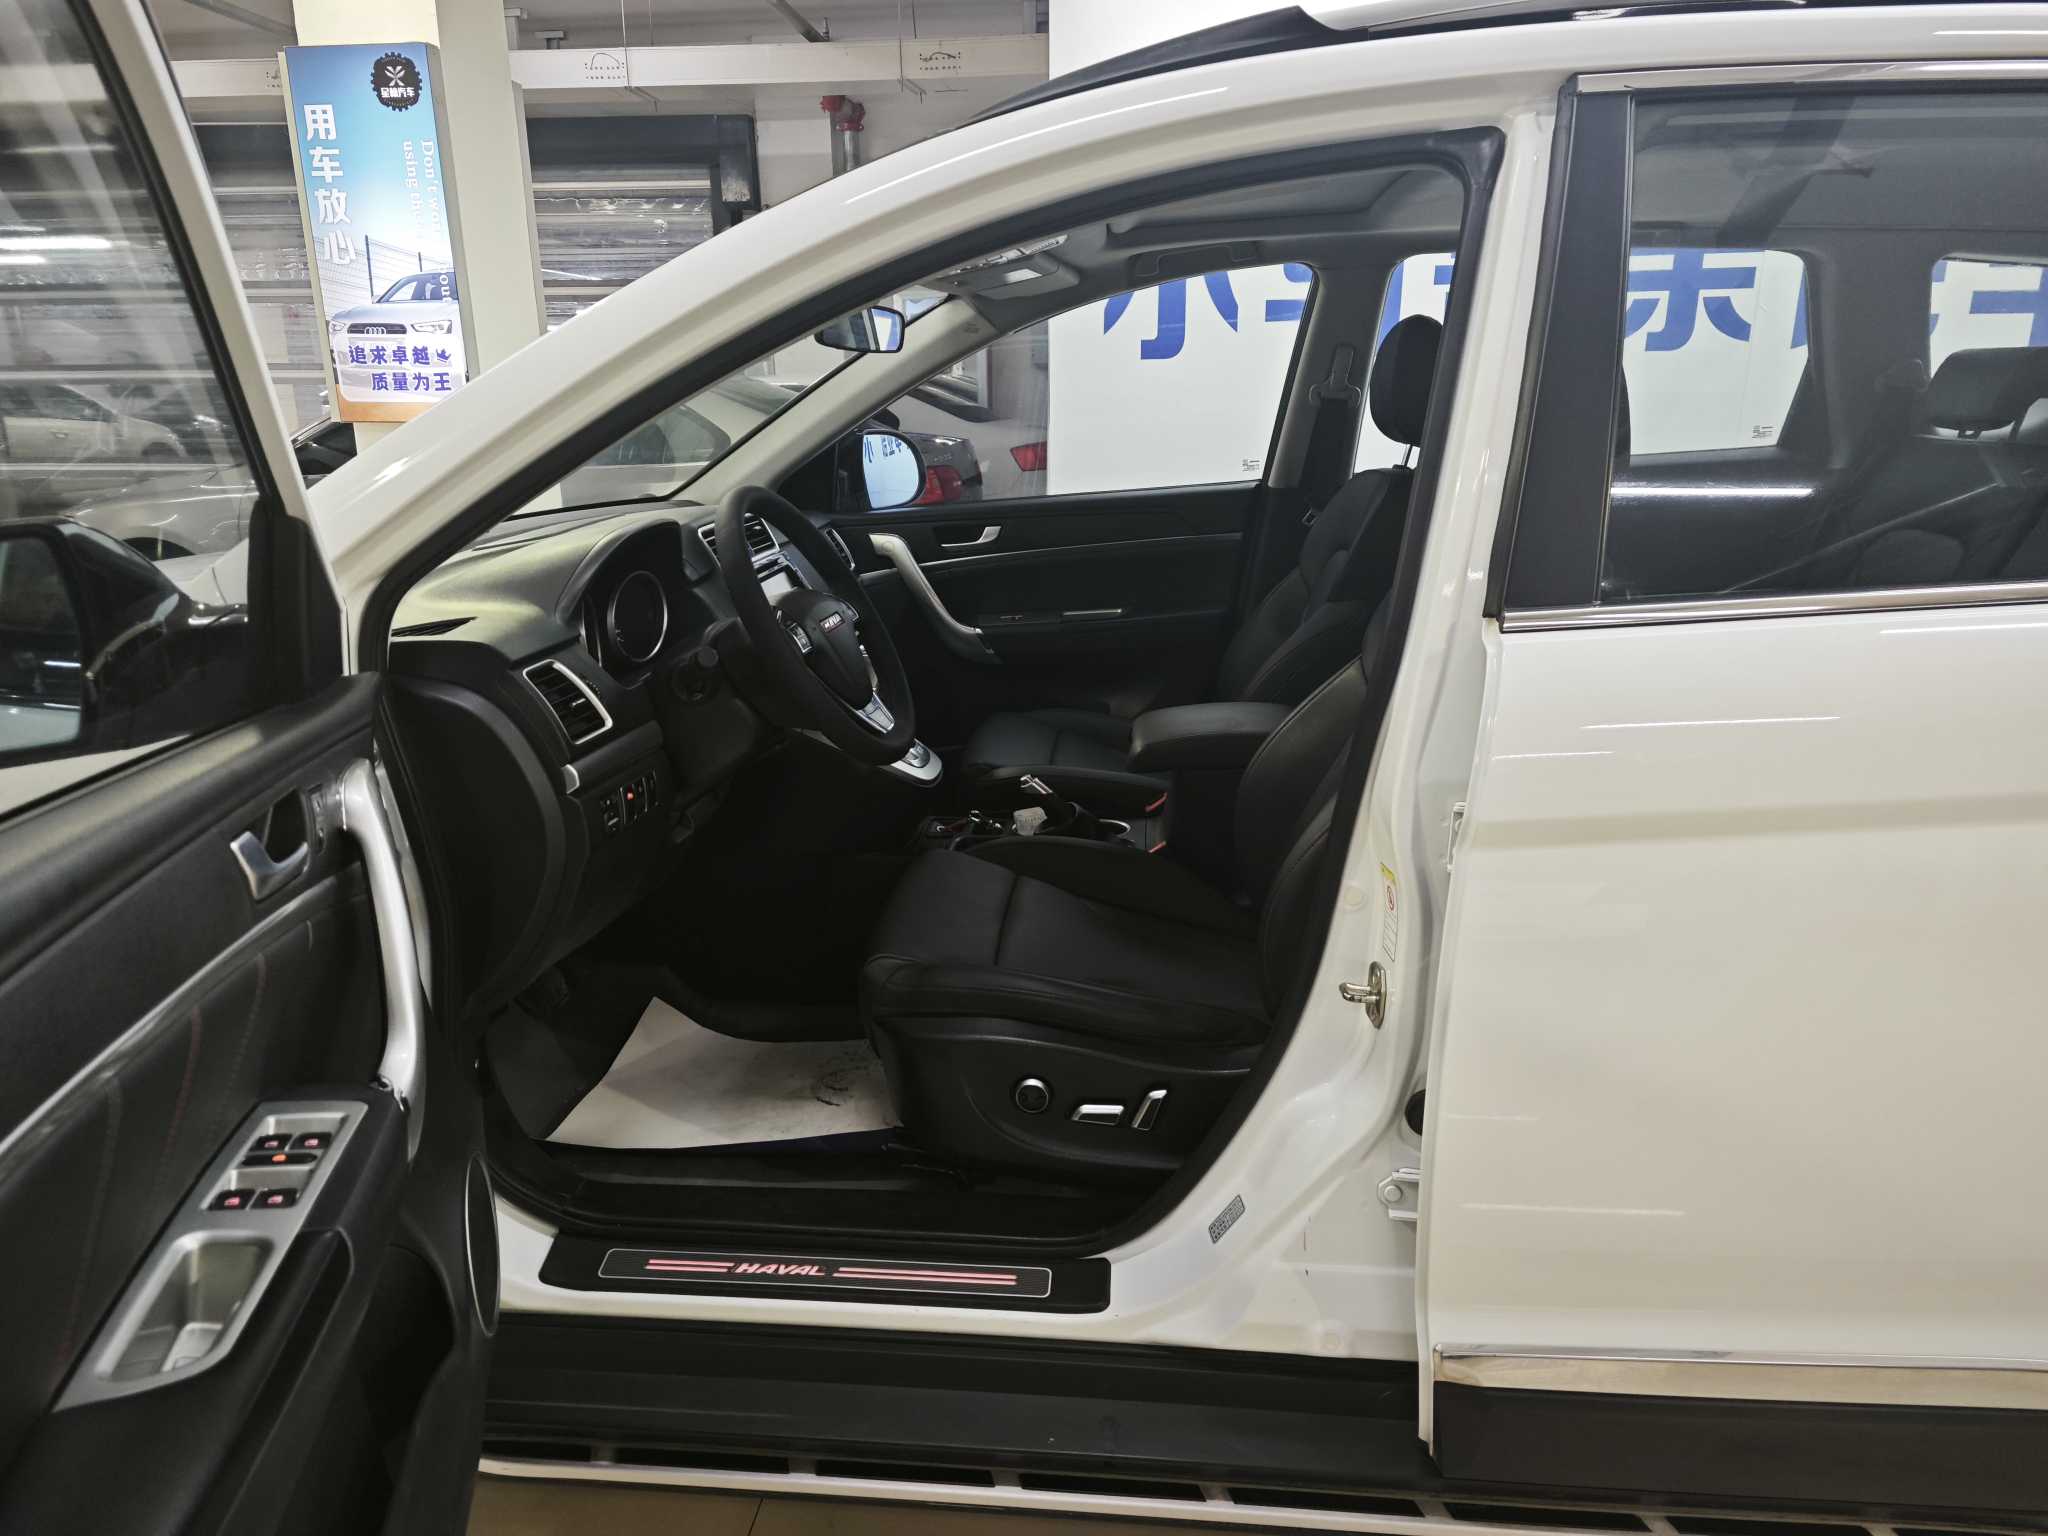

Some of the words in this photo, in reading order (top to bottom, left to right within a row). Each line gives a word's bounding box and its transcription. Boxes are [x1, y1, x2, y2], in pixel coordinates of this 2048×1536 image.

[402, 139, 419, 189] using
[421, 138, 439, 193] Don't
[303, 104, 356, 265] 用车放心
[348, 345, 431, 366] 追求卓越
[371, 371, 452, 391] 质量为王
[735, 1262, 825, 1276] HAVAL
